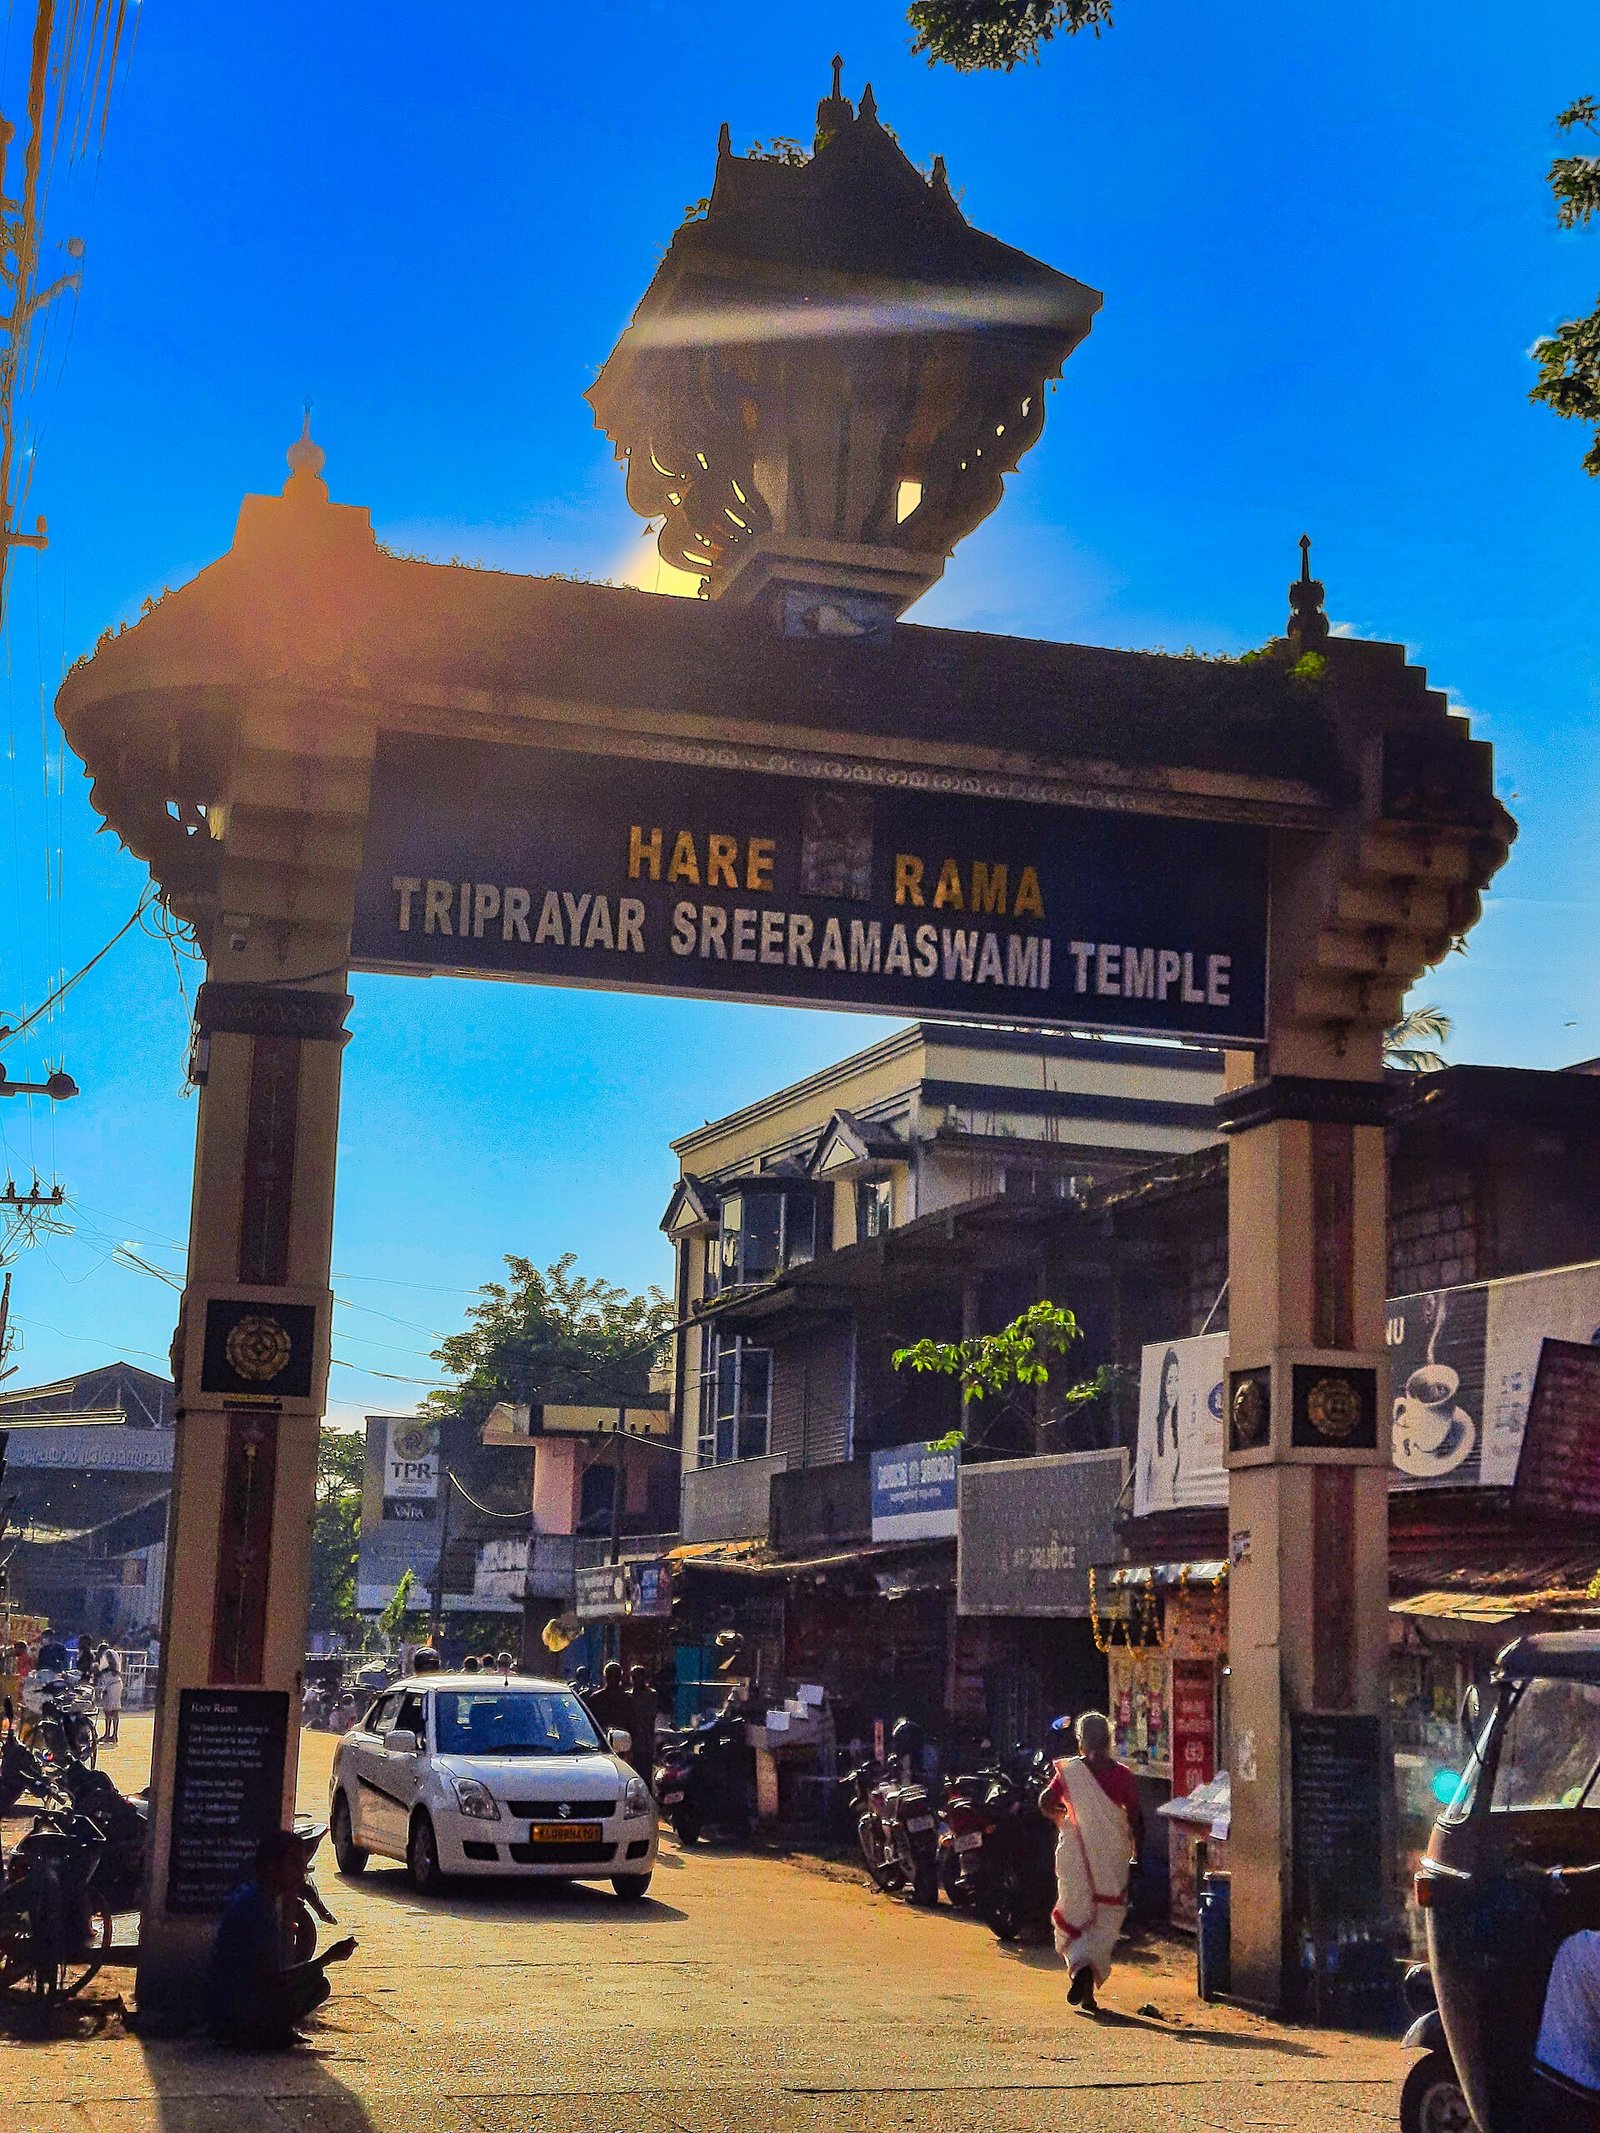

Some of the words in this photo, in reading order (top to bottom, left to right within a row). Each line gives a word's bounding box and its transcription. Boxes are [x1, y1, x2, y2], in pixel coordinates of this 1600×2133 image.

[626, 825, 776, 892] HARE
[894, 853, 1045, 919] RAMA
[391, 876, 646, 953] TRIPRAYAR
[671, 900, 1053, 990] SREERAMASWAMI
[1070, 939, 1231, 1008] TEMPLE
[391, 1461, 432, 1479] TPR
